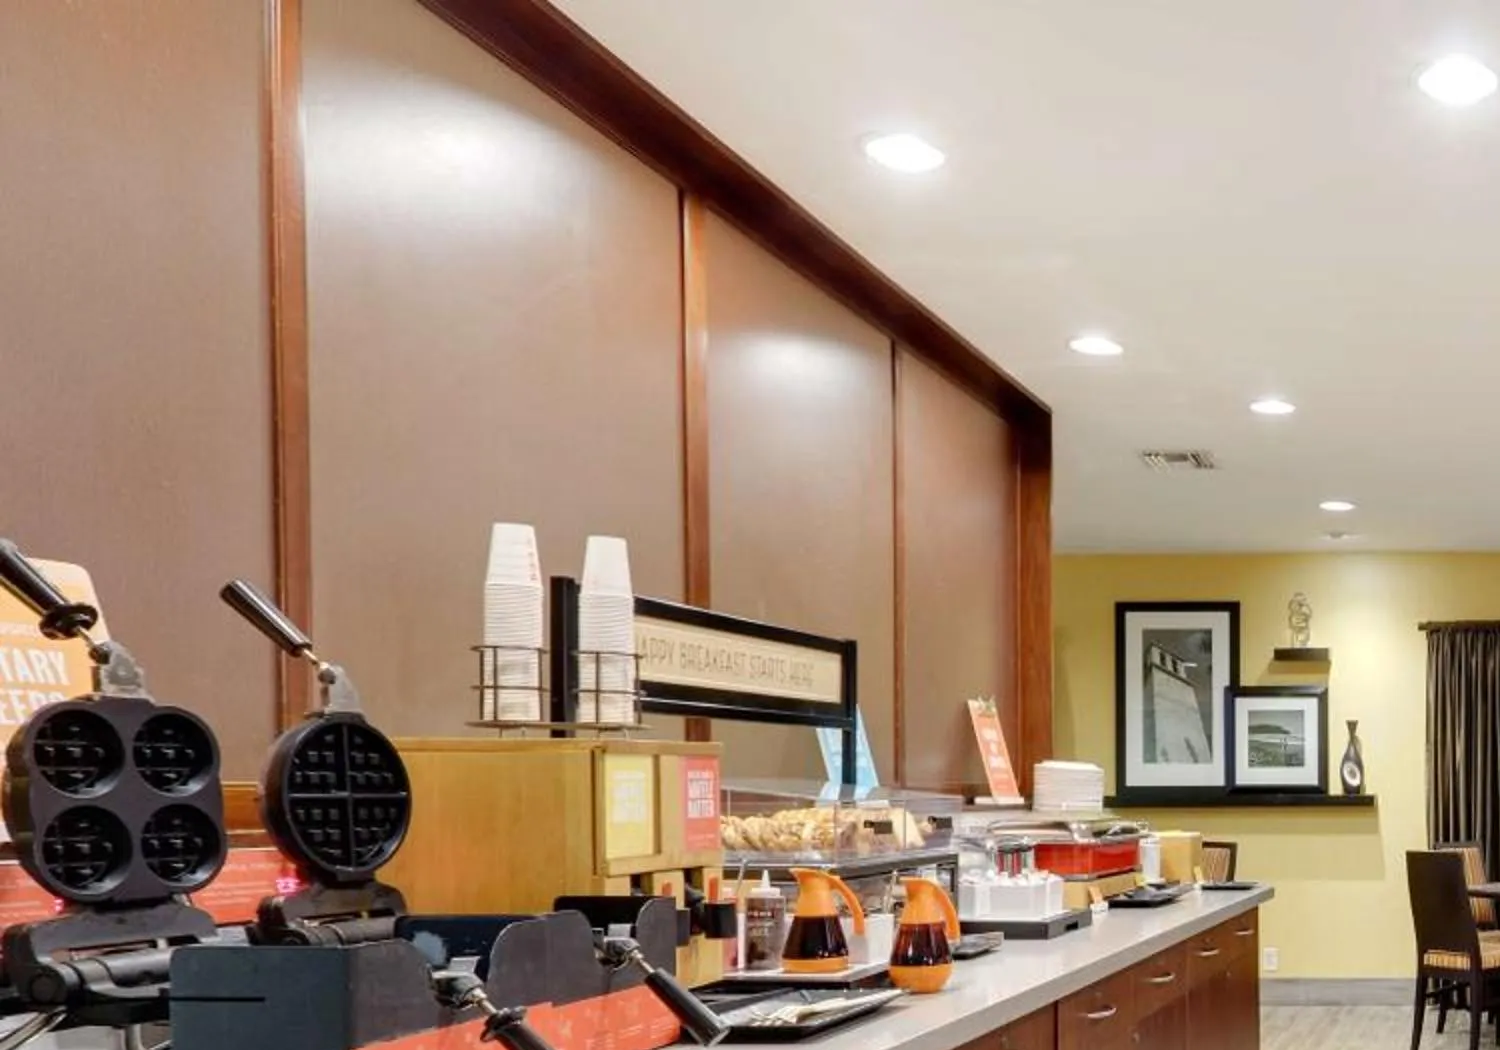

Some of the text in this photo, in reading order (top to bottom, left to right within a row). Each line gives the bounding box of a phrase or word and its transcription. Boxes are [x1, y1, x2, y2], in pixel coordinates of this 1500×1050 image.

[636, 635, 675, 665] APPY
[680, 641, 747, 677] BREAKFAST
[749, 654, 787, 685] STARTS
